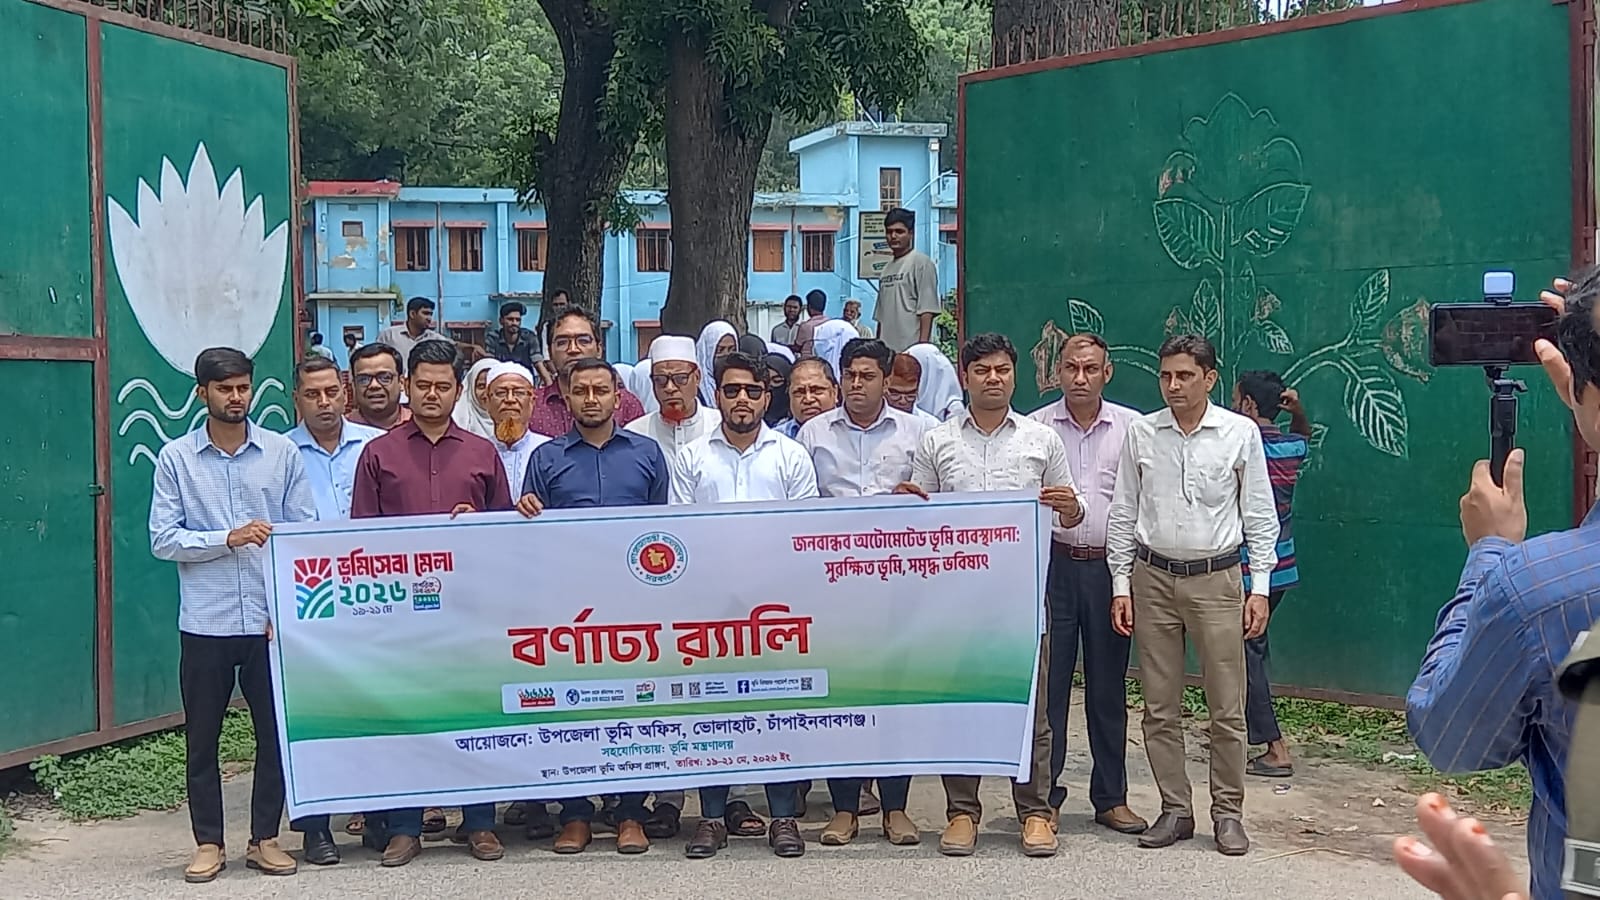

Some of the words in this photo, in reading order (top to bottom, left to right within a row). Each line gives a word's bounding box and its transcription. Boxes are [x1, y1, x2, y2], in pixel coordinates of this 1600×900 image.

[791, 534, 851, 552] জনবান্ধব
[852, 527, 927, 549] অটোমেটেড
[928, 525, 954, 552] ভূমি
[956, 526, 1020, 546] ব্যবস্থাপনা:
[336, 547, 409, 584] ভূমিসেবা
[413, 551, 453, 577] মেলা
[824, 556, 876, 583] সুরক্ষিত
[876, 554, 906, 581] ভূমি,
[907, 557, 941, 579] সমৃদ্ধ
[942, 551, 989, 571] ভবিষ্যৎ
[338, 580, 406, 606] ২০২৬
[352, 606, 381, 616] ১৯-২১
[382, 605, 392, 613] মে
[507, 607, 662, 666] বর্ণাঢ্য
[455, 732, 533, 752] আয়োজনে:
[537, 726, 601, 744] উপজেলা
[604, 721, 634, 745] ভূমি
[637, 719, 687, 739] অফিস,
[692, 715, 762, 735] ভোলাহাট,
[766, 712, 866, 731] চাঁপাইনবাবগঞ্জ
[601, 743, 665, 757] সহযোগিতায়:
[668, 740, 689, 756] ভূমি
[691, 739, 735, 752] মন্ত্রণালয়
[562, 764, 597, 776] উপজেলা
[599, 763, 616, 776] ভূমি
[617, 760, 642, 772] অফিস
[705, 758, 734, 767] ১৯-২১
[736, 755, 751, 765] মে,
[752, 754, 778, 763] ২০২৬
